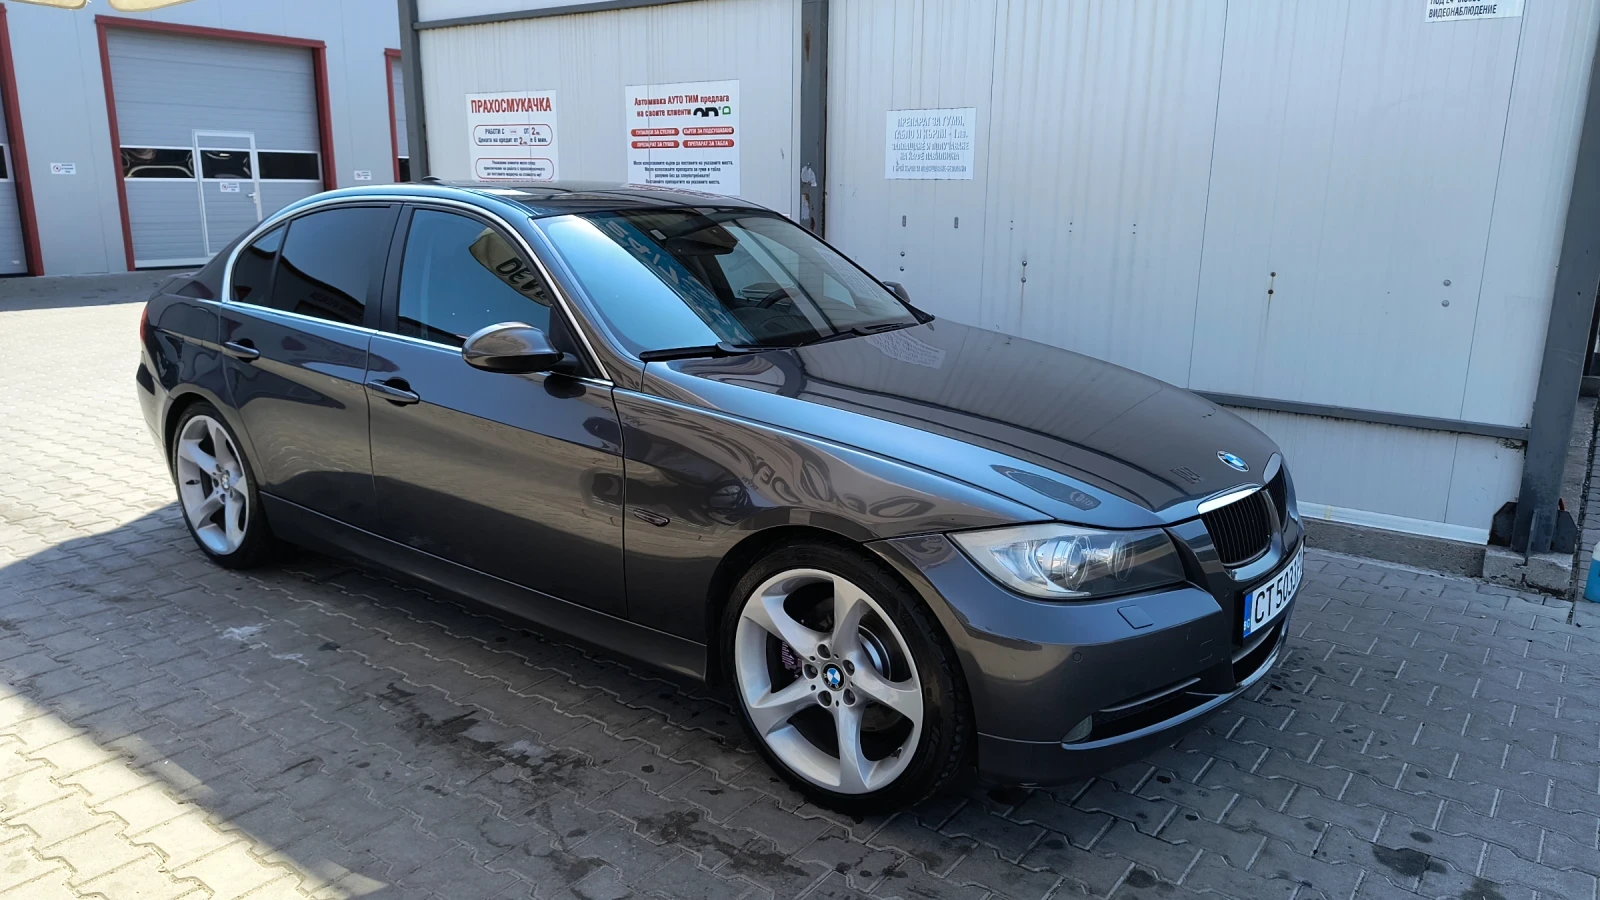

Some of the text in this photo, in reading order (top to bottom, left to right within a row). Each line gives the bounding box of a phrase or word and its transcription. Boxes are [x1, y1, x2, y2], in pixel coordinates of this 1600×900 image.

[1428, 4, 1497, 19] ВИДЕОНАБЛЮДЕНИЕ
[471, 97, 552, 114] ПРАХОСМУКАЧКА
[634, 94, 730, 106] Автомивка АУТО ТИМ предлага
[645, 109, 665, 117] своите
[666, 108, 692, 116] клиенти
[898, 117, 931, 128] ПРЕПАРАТ
